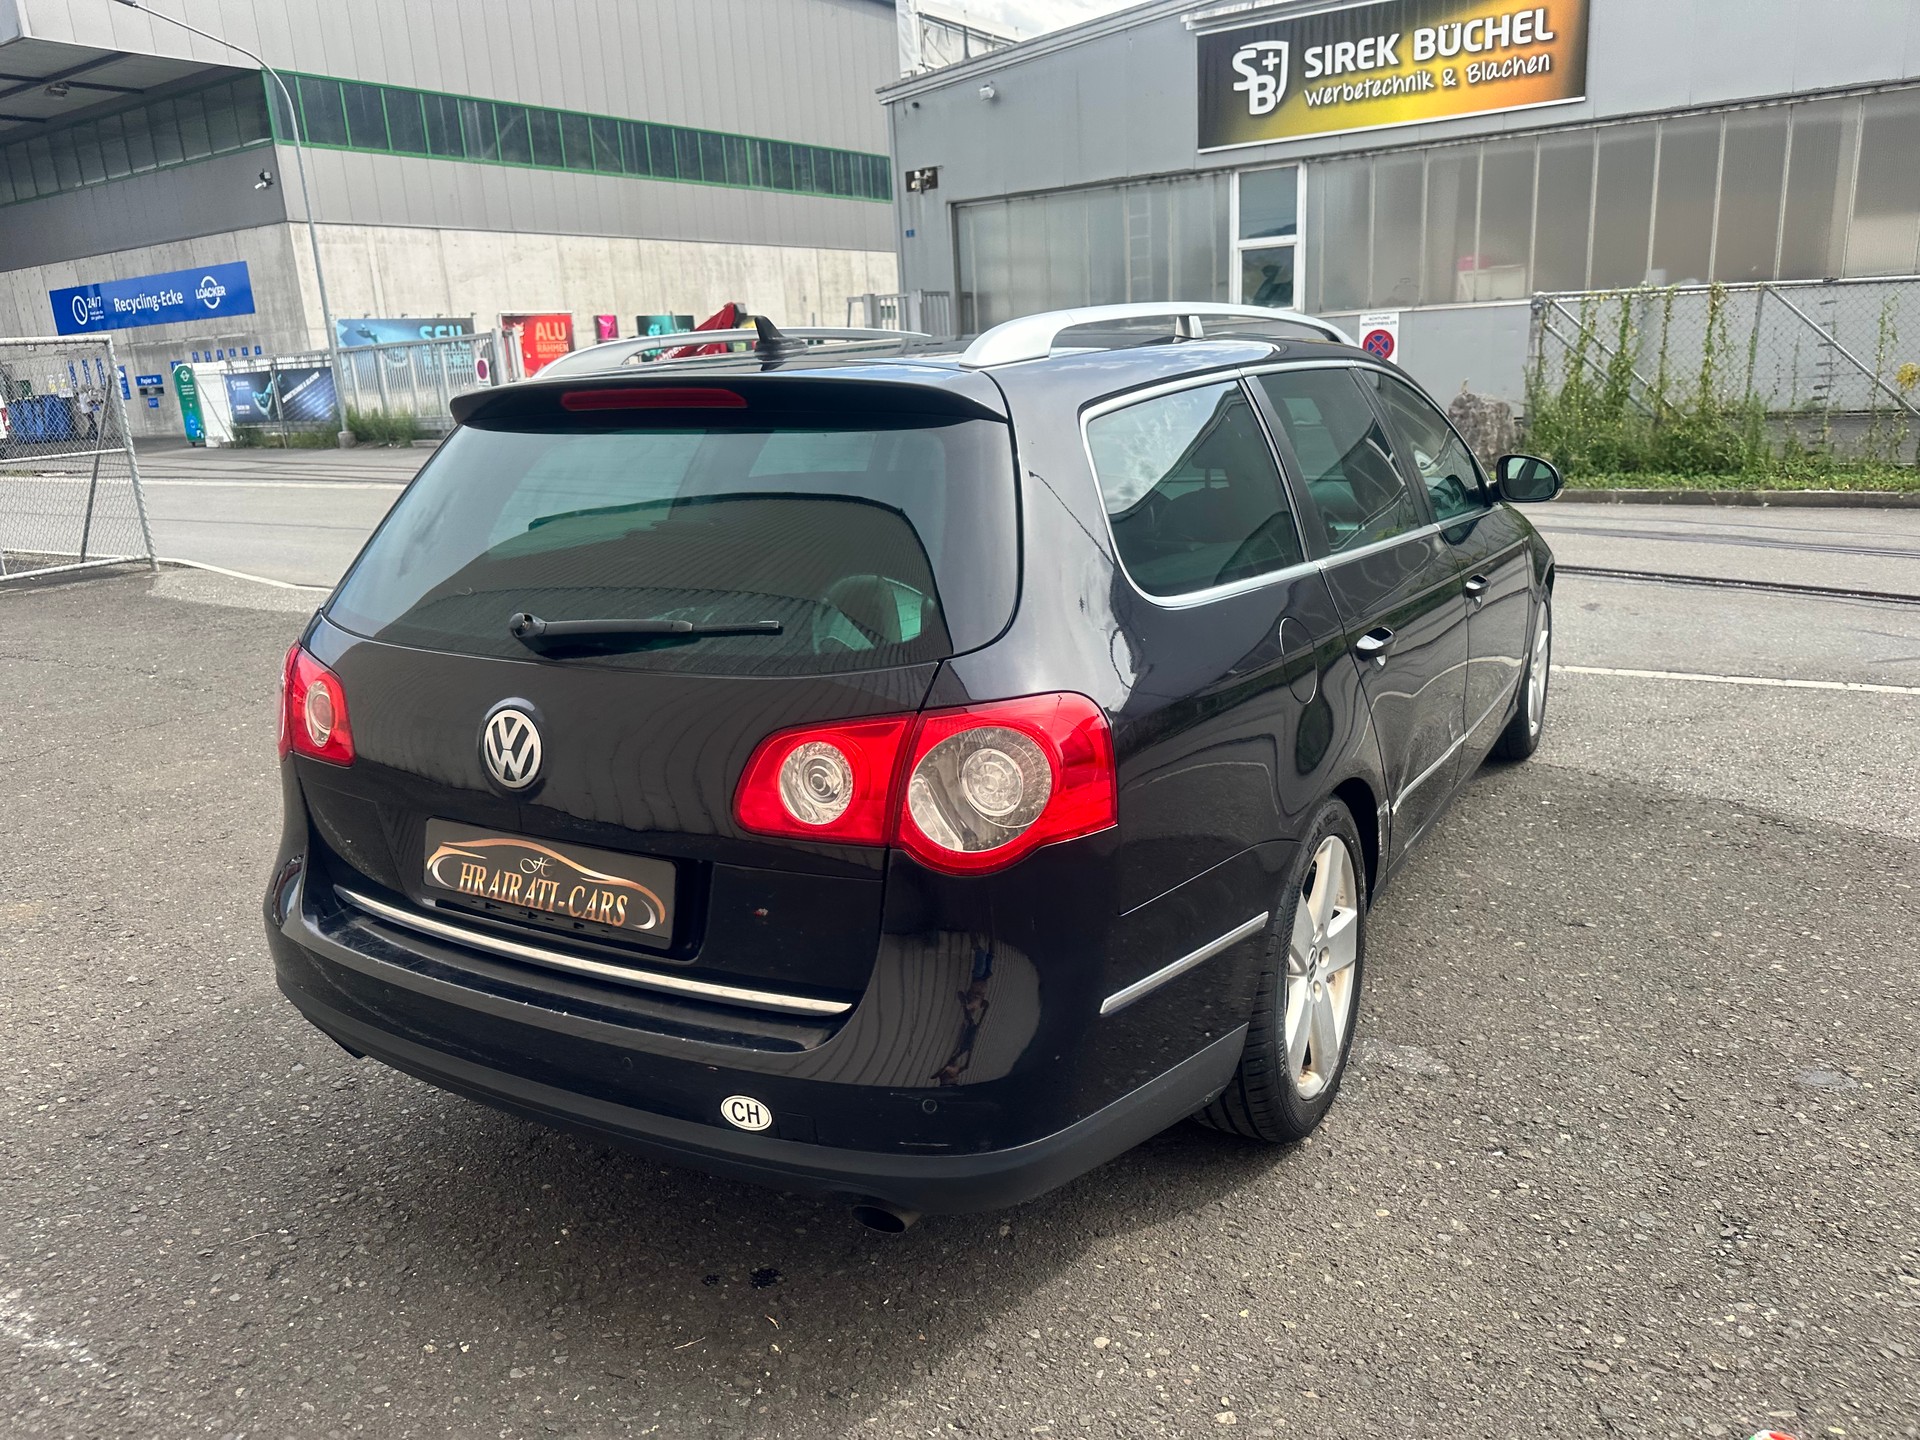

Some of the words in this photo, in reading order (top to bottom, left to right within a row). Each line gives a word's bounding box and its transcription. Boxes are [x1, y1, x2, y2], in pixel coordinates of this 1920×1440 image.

[1304, 33, 1400, 79] SIREK
[1413, 8, 1554, 61] BÜCHEL
[1442, 68, 1457, 87] &
[1466, 53, 1551, 84] Blachen
[113, 289, 184, 315] Recycling-Ecke
[195, 285, 227, 300] LOACKER
[535, 321, 567, 341] ALU
[457, 862, 628, 927] HRAIRATI-CARS
[731, 1101, 761, 1125] CH
